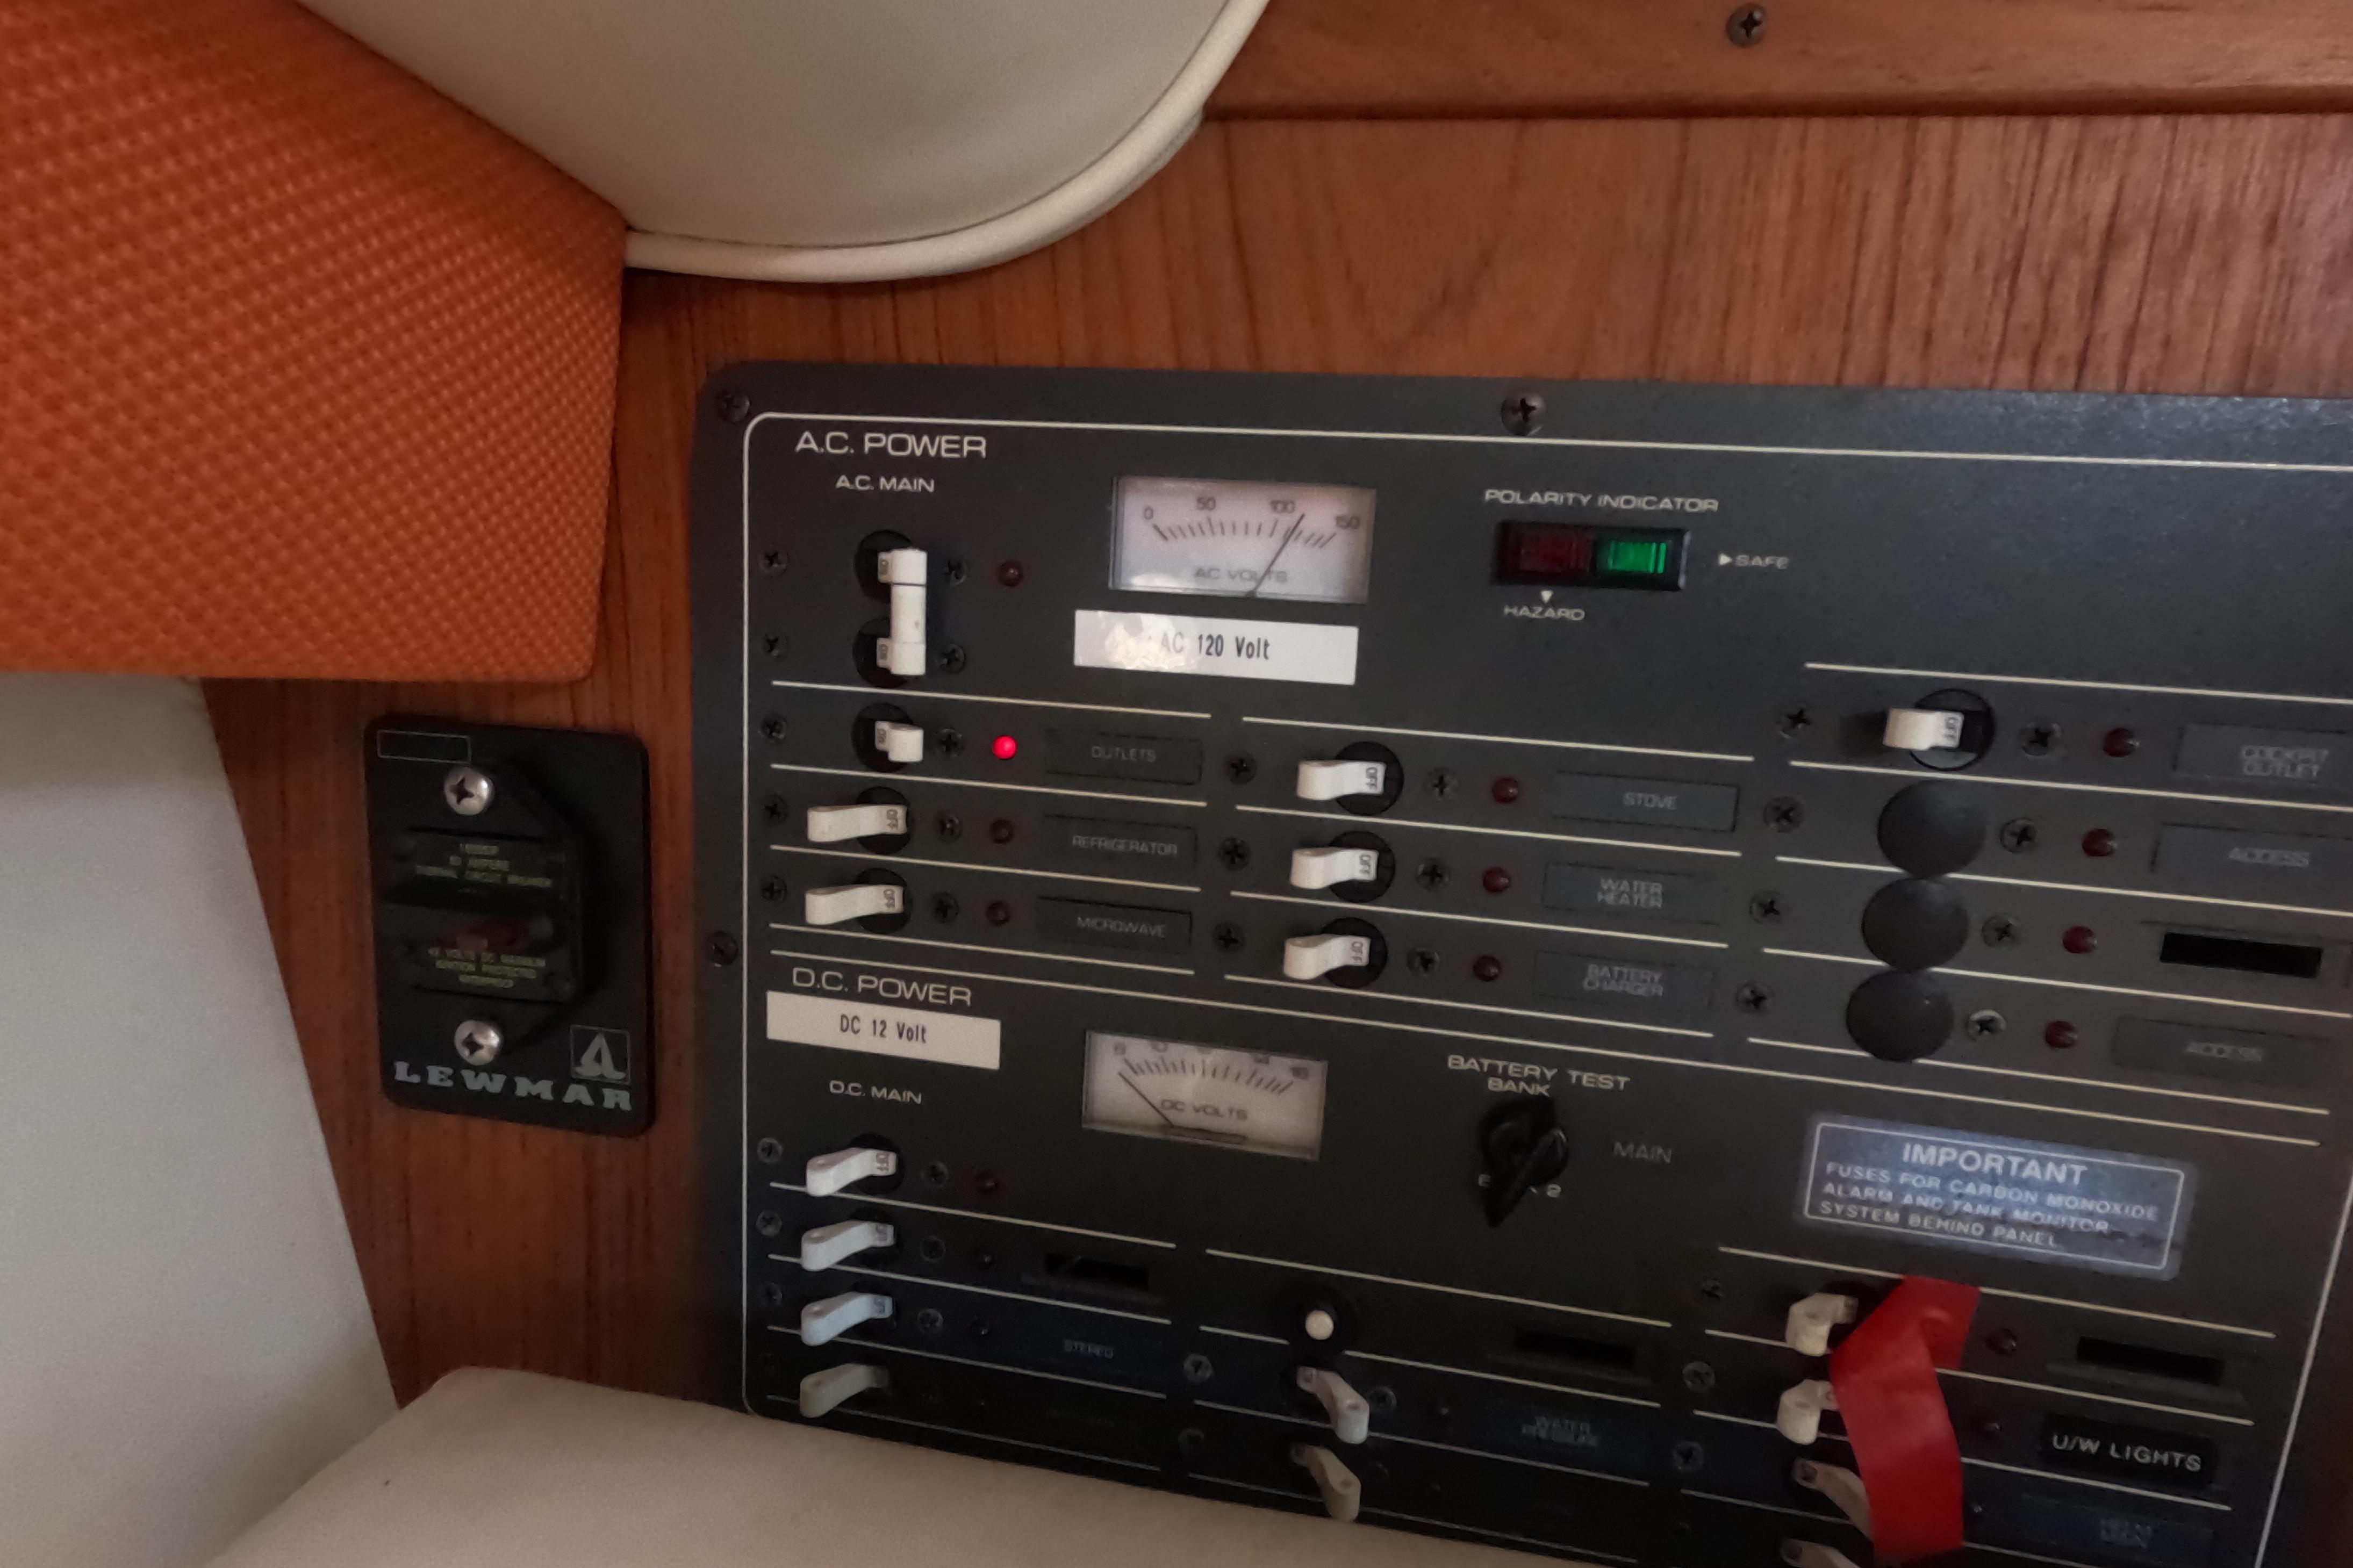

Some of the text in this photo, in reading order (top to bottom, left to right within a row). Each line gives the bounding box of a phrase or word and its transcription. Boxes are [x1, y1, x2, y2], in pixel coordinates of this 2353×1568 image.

[795, 430, 986, 458] A.C. POWER
[835, 474, 935, 492] A.C. MAIN
[1196, 497, 1216, 511] 50
[1484, 489, 1719, 513] POLARITY INDICATOR
[1143, 506, 1154, 521] 0
[1735, 554, 1789, 570] SAFE
[1194, 567, 1221, 581] AC
[1504, 605, 1585, 621] HAZARD
[1160, 631, 1269, 661] AC 120 Volt
[1091, 745, 1157, 763] OUTLETS
[1622, 791, 1678, 810] STOVE
[1072, 834, 1178, 858] REFRIGERATOR
[1599, 876, 1662, 893] WATER
[1077, 916, 1167, 938] MICROWAVE
[1586, 963, 1664, 983] BATTERY
[792, 967, 971, 1007] D.C. POWER
[840, 1013, 927, 1044] DC 12 Volt
[1447, 1054, 1631, 1091] BATTERY TEST
[393, 1060, 633, 1111] LEWMAR
[871, 1087, 922, 1104] MAIN
[1488, 1076, 1550, 1097] BANK
[1161, 1099, 1248, 1120] DC VOLTS
[1612, 1141, 1672, 1163] MAIN
[1902, 1142, 2089, 1186] IMPORTANT
[1826, 1161, 2158, 1222] FUSES FOR CARBON MONOXIDE
[1823, 1181, 1893, 1203] ALARM
[1903, 1193, 1944, 1211] AND
[2012, 1209, 2110, 1233] MONITOR
[1820, 1200, 2055, 1248] SYSTEM BEHIND PANEL
[2052, 1432, 2202, 1472] U/W LIGHTS
